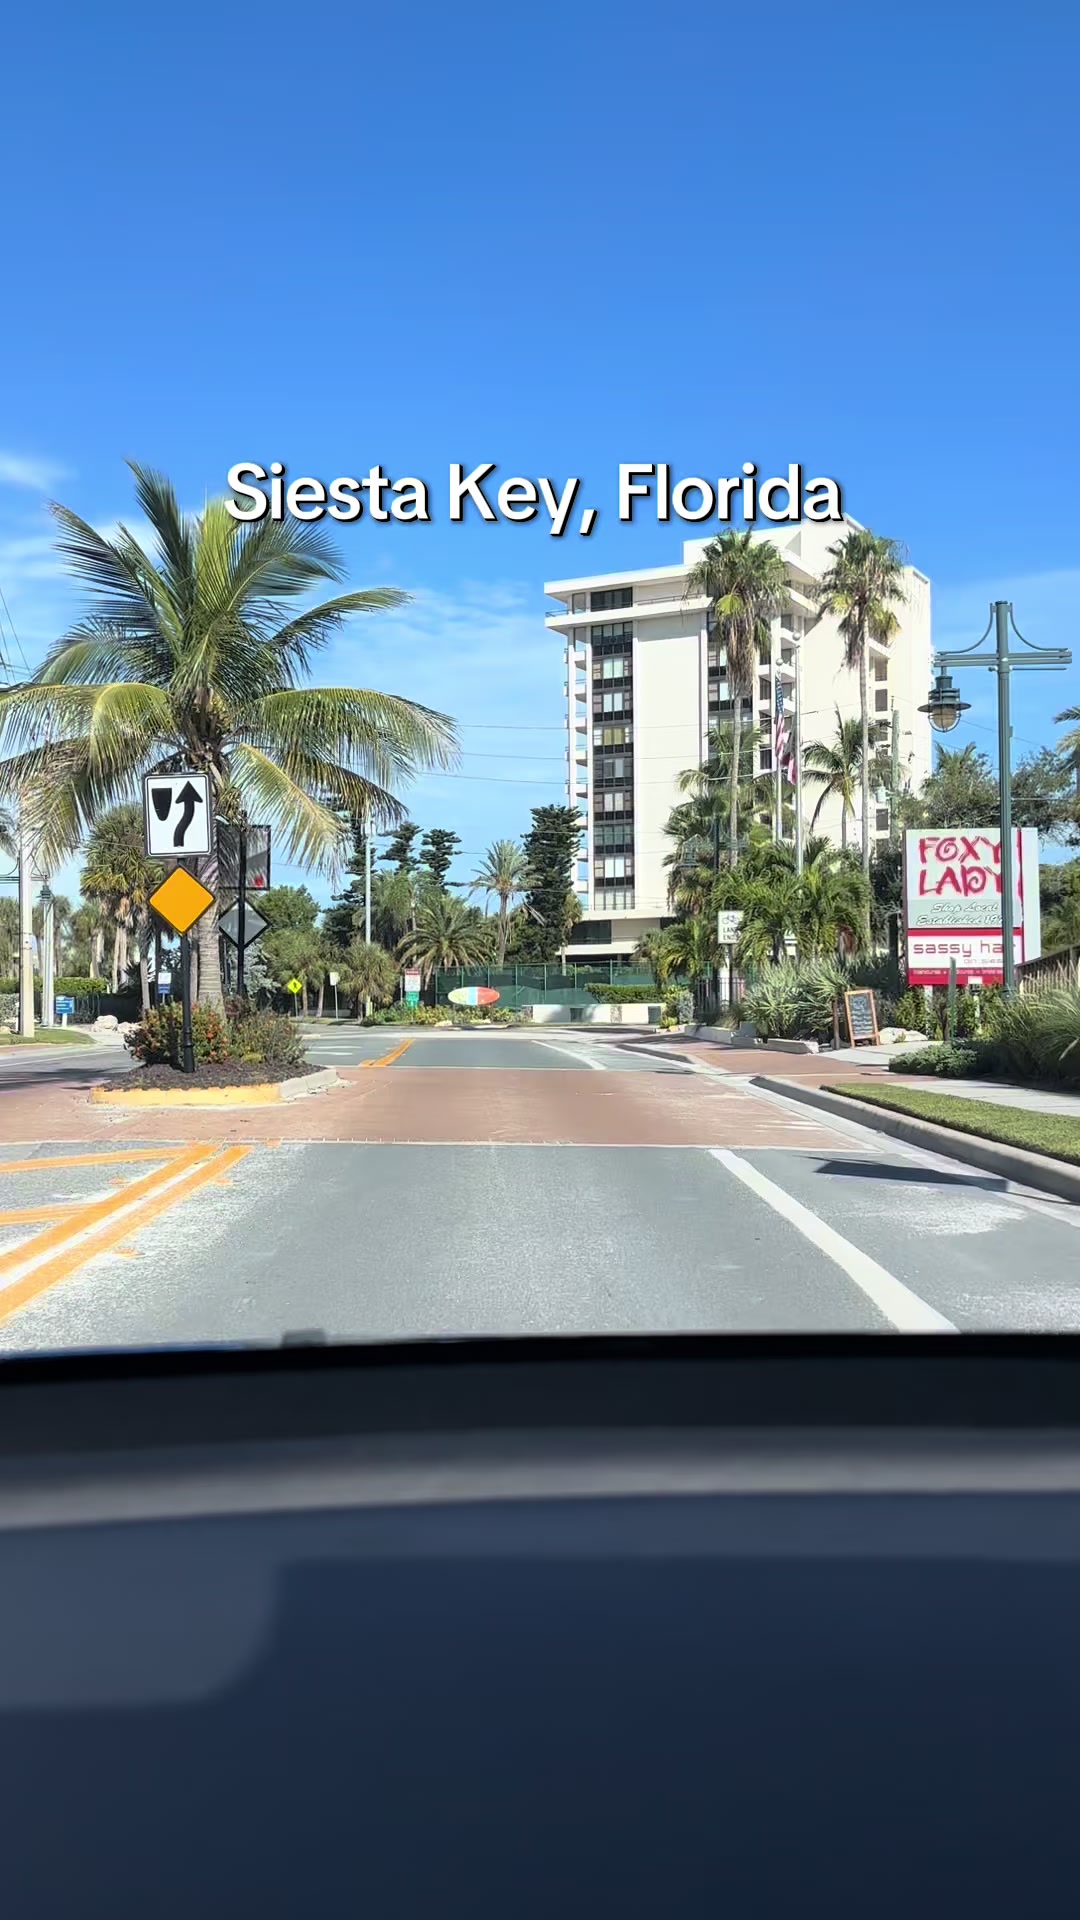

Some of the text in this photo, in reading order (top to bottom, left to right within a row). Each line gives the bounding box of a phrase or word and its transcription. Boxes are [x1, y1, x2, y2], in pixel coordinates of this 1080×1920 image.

[919, 836, 1001, 864] FOXY
[919, 865, 1002, 896] LADY
[931, 902, 998, 914] Shop Local
[916, 914, 983, 926] Established
[913, 943, 972, 957] sassy
